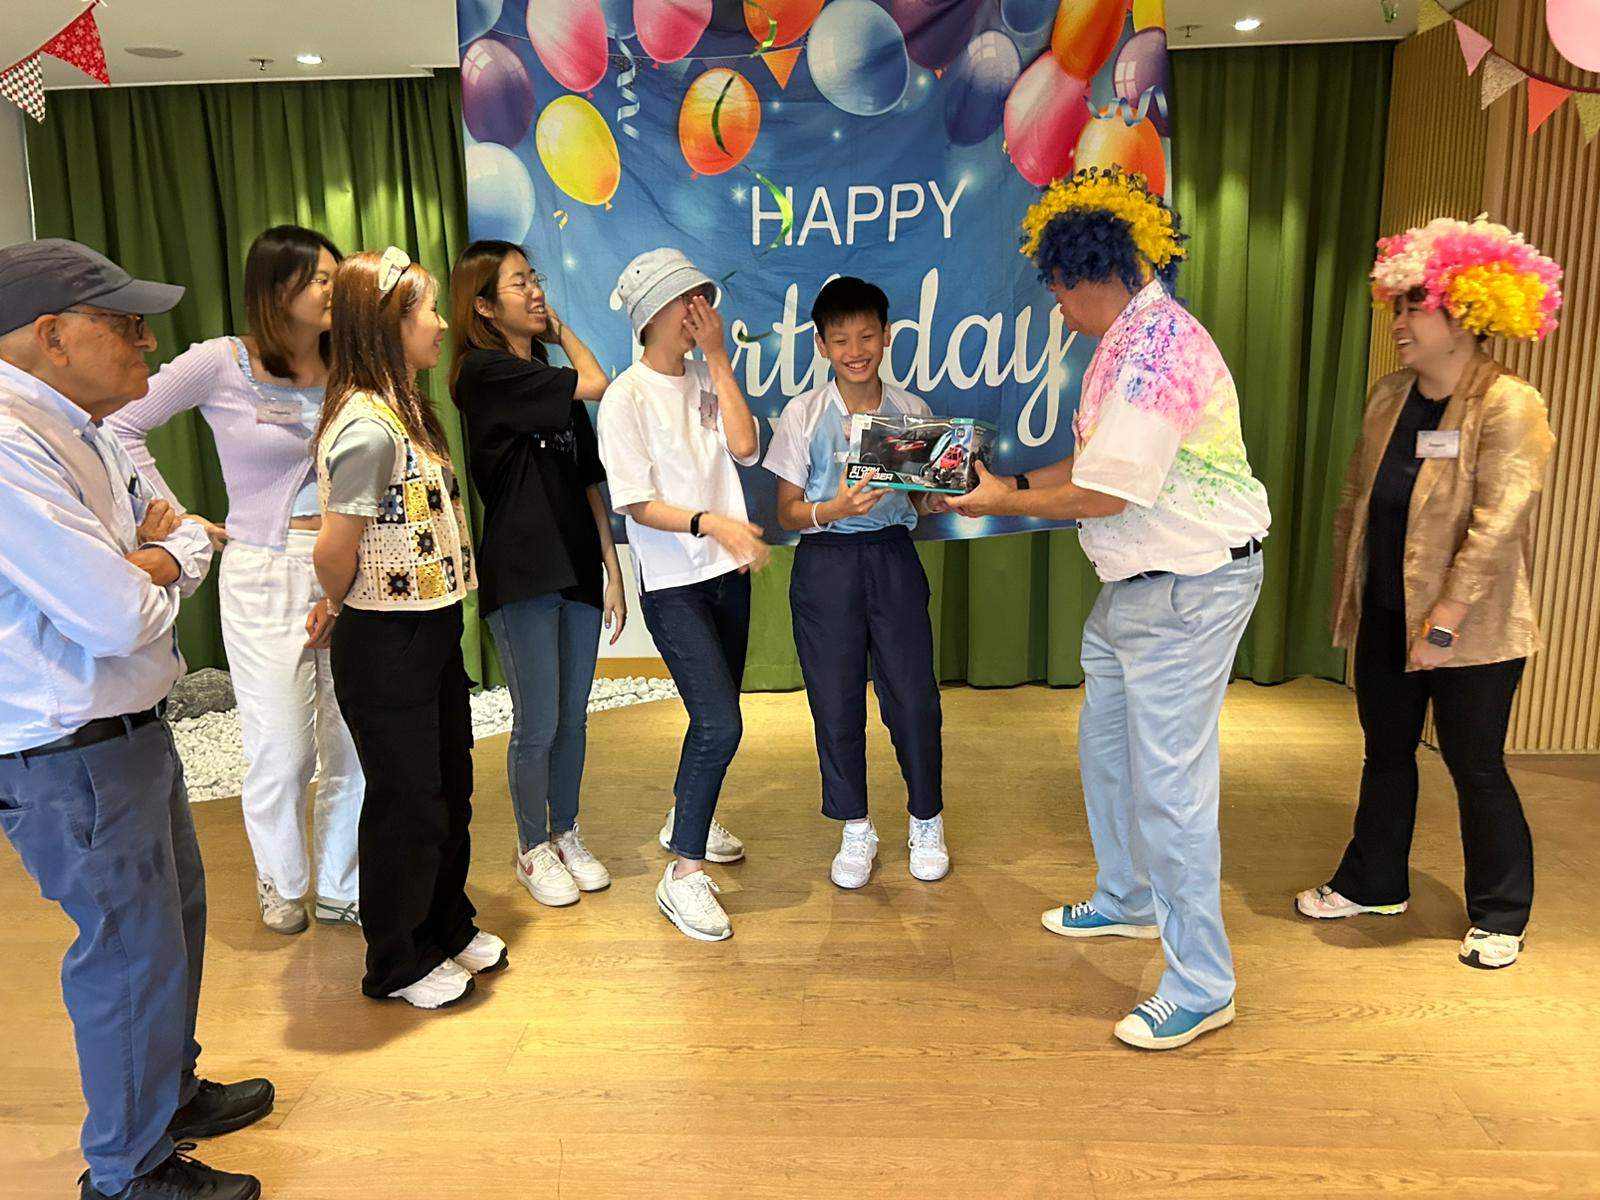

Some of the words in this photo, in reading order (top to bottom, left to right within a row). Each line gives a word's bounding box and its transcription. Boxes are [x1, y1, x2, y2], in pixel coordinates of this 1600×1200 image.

[751, 179, 967, 247] HAPPY
[609, 267, 1079, 447] rtday
[848, 471, 893, 480] CLIBER
